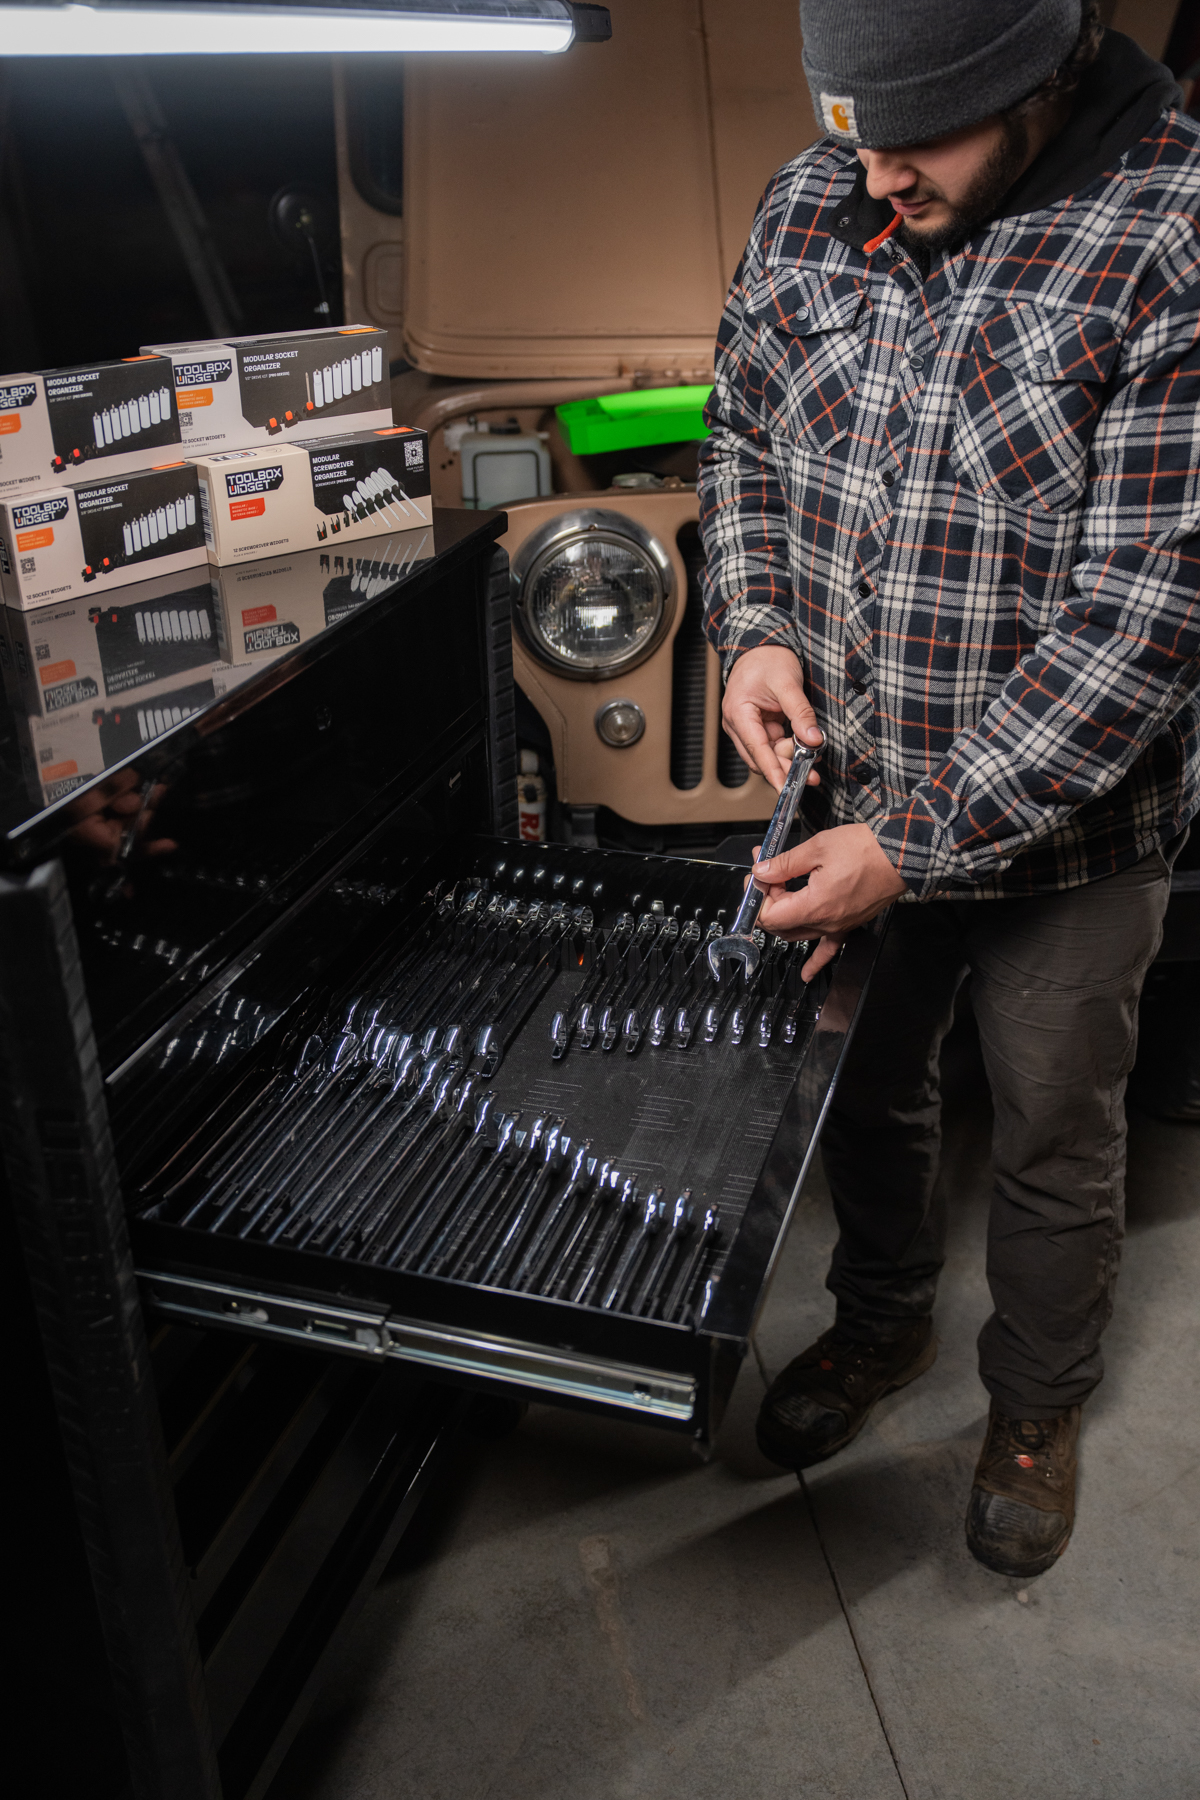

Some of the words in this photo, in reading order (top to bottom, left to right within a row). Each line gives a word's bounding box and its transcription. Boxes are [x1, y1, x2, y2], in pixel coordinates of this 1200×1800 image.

[243, 354, 274, 363] MODULAR
[275, 350, 298, 359] SOCKET
[175, 361, 230, 376] TOOLBOX
[244, 362, 280, 372] ORGANIZER
[47, 376, 76, 387] MODULAR
[77, 372, 100, 382] SOCKET
[48, 384, 83, 396] ORGANIZER
[312, 454, 340, 464] MODULAR
[314, 460, 354, 472] SCREWDRIVER
[227, 468, 282, 485] TOOLBOX
[315, 470, 347, 481] ORGANIZER
[78, 488, 106, 500] MODULAR
[107, 483, 128, 494] SOCKET
[79, 496, 113, 508] ORGANIZER
[14, 499, 67, 518] TOOLBOX
